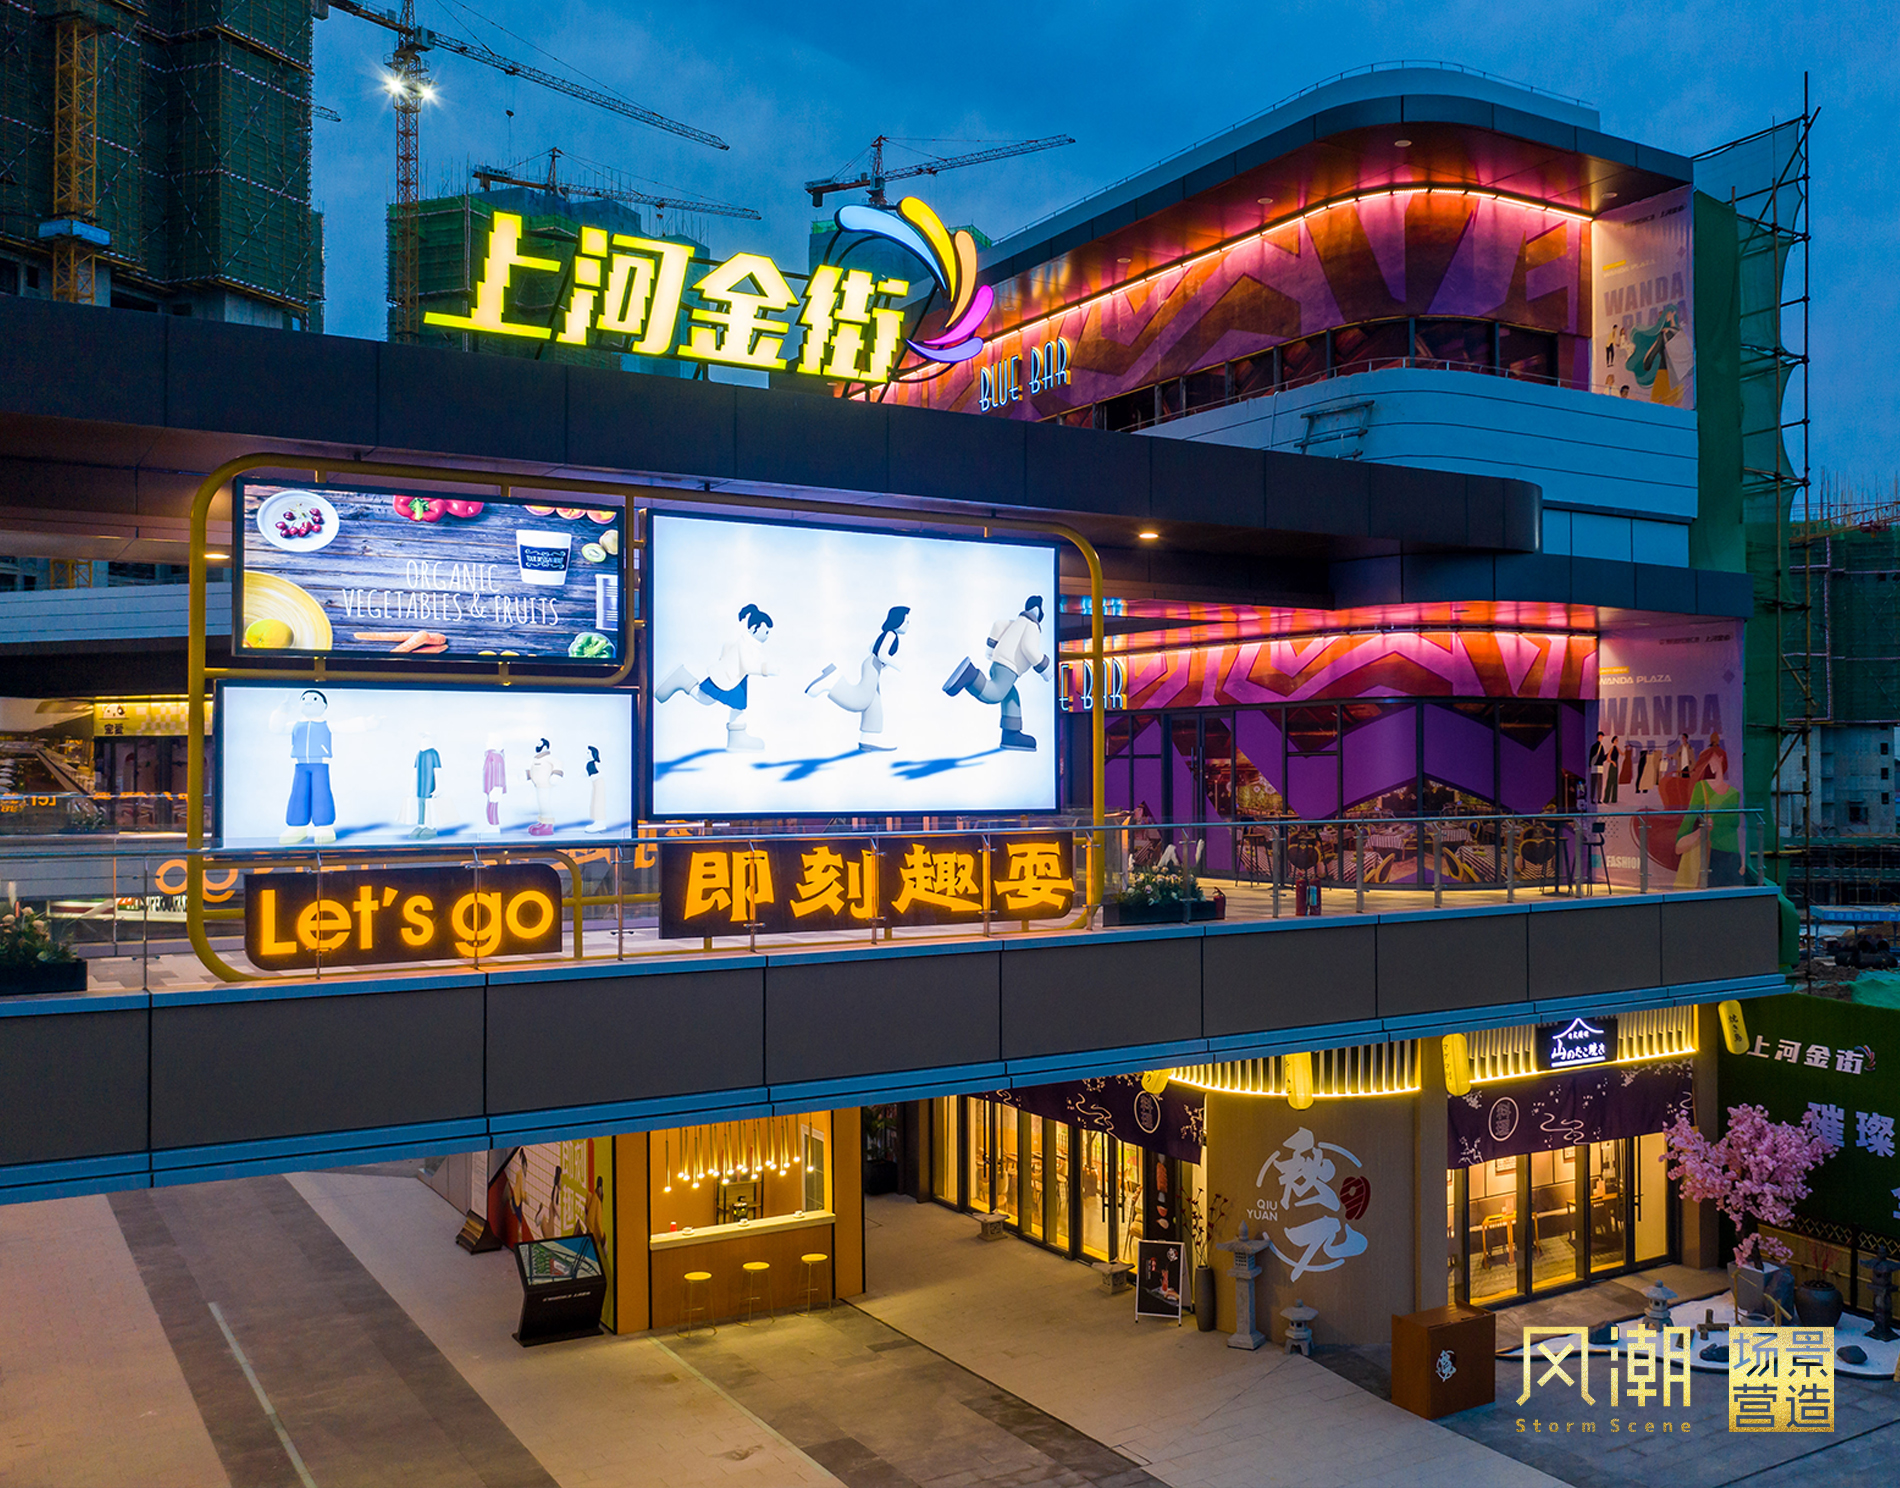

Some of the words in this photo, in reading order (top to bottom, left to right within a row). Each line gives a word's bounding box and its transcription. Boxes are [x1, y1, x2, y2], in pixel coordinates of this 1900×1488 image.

[424, 211, 910, 384] 上河金街
[1603, 271, 1685, 317] WANDA
[978, 354, 1023, 413] BLUE
[1028, 336, 1071, 395] BAR
[405, 559, 501, 593] ORGANIC
[341, 588, 463, 621] VEGETABLES
[469, 592, 488, 618] &
[494, 594, 560, 626] FRUITS
[1600, 693, 1724, 737] WANDA
[684, 840, 1076, 922] 即刻趣耍
[260, 884, 436, 957] Let's
[451, 888, 556, 959] go
[1747, 1034, 1864, 1075] 上河金街
[1247, 1209, 1279, 1222] YUAN
[1256, 1199, 1279, 1211] QIU
